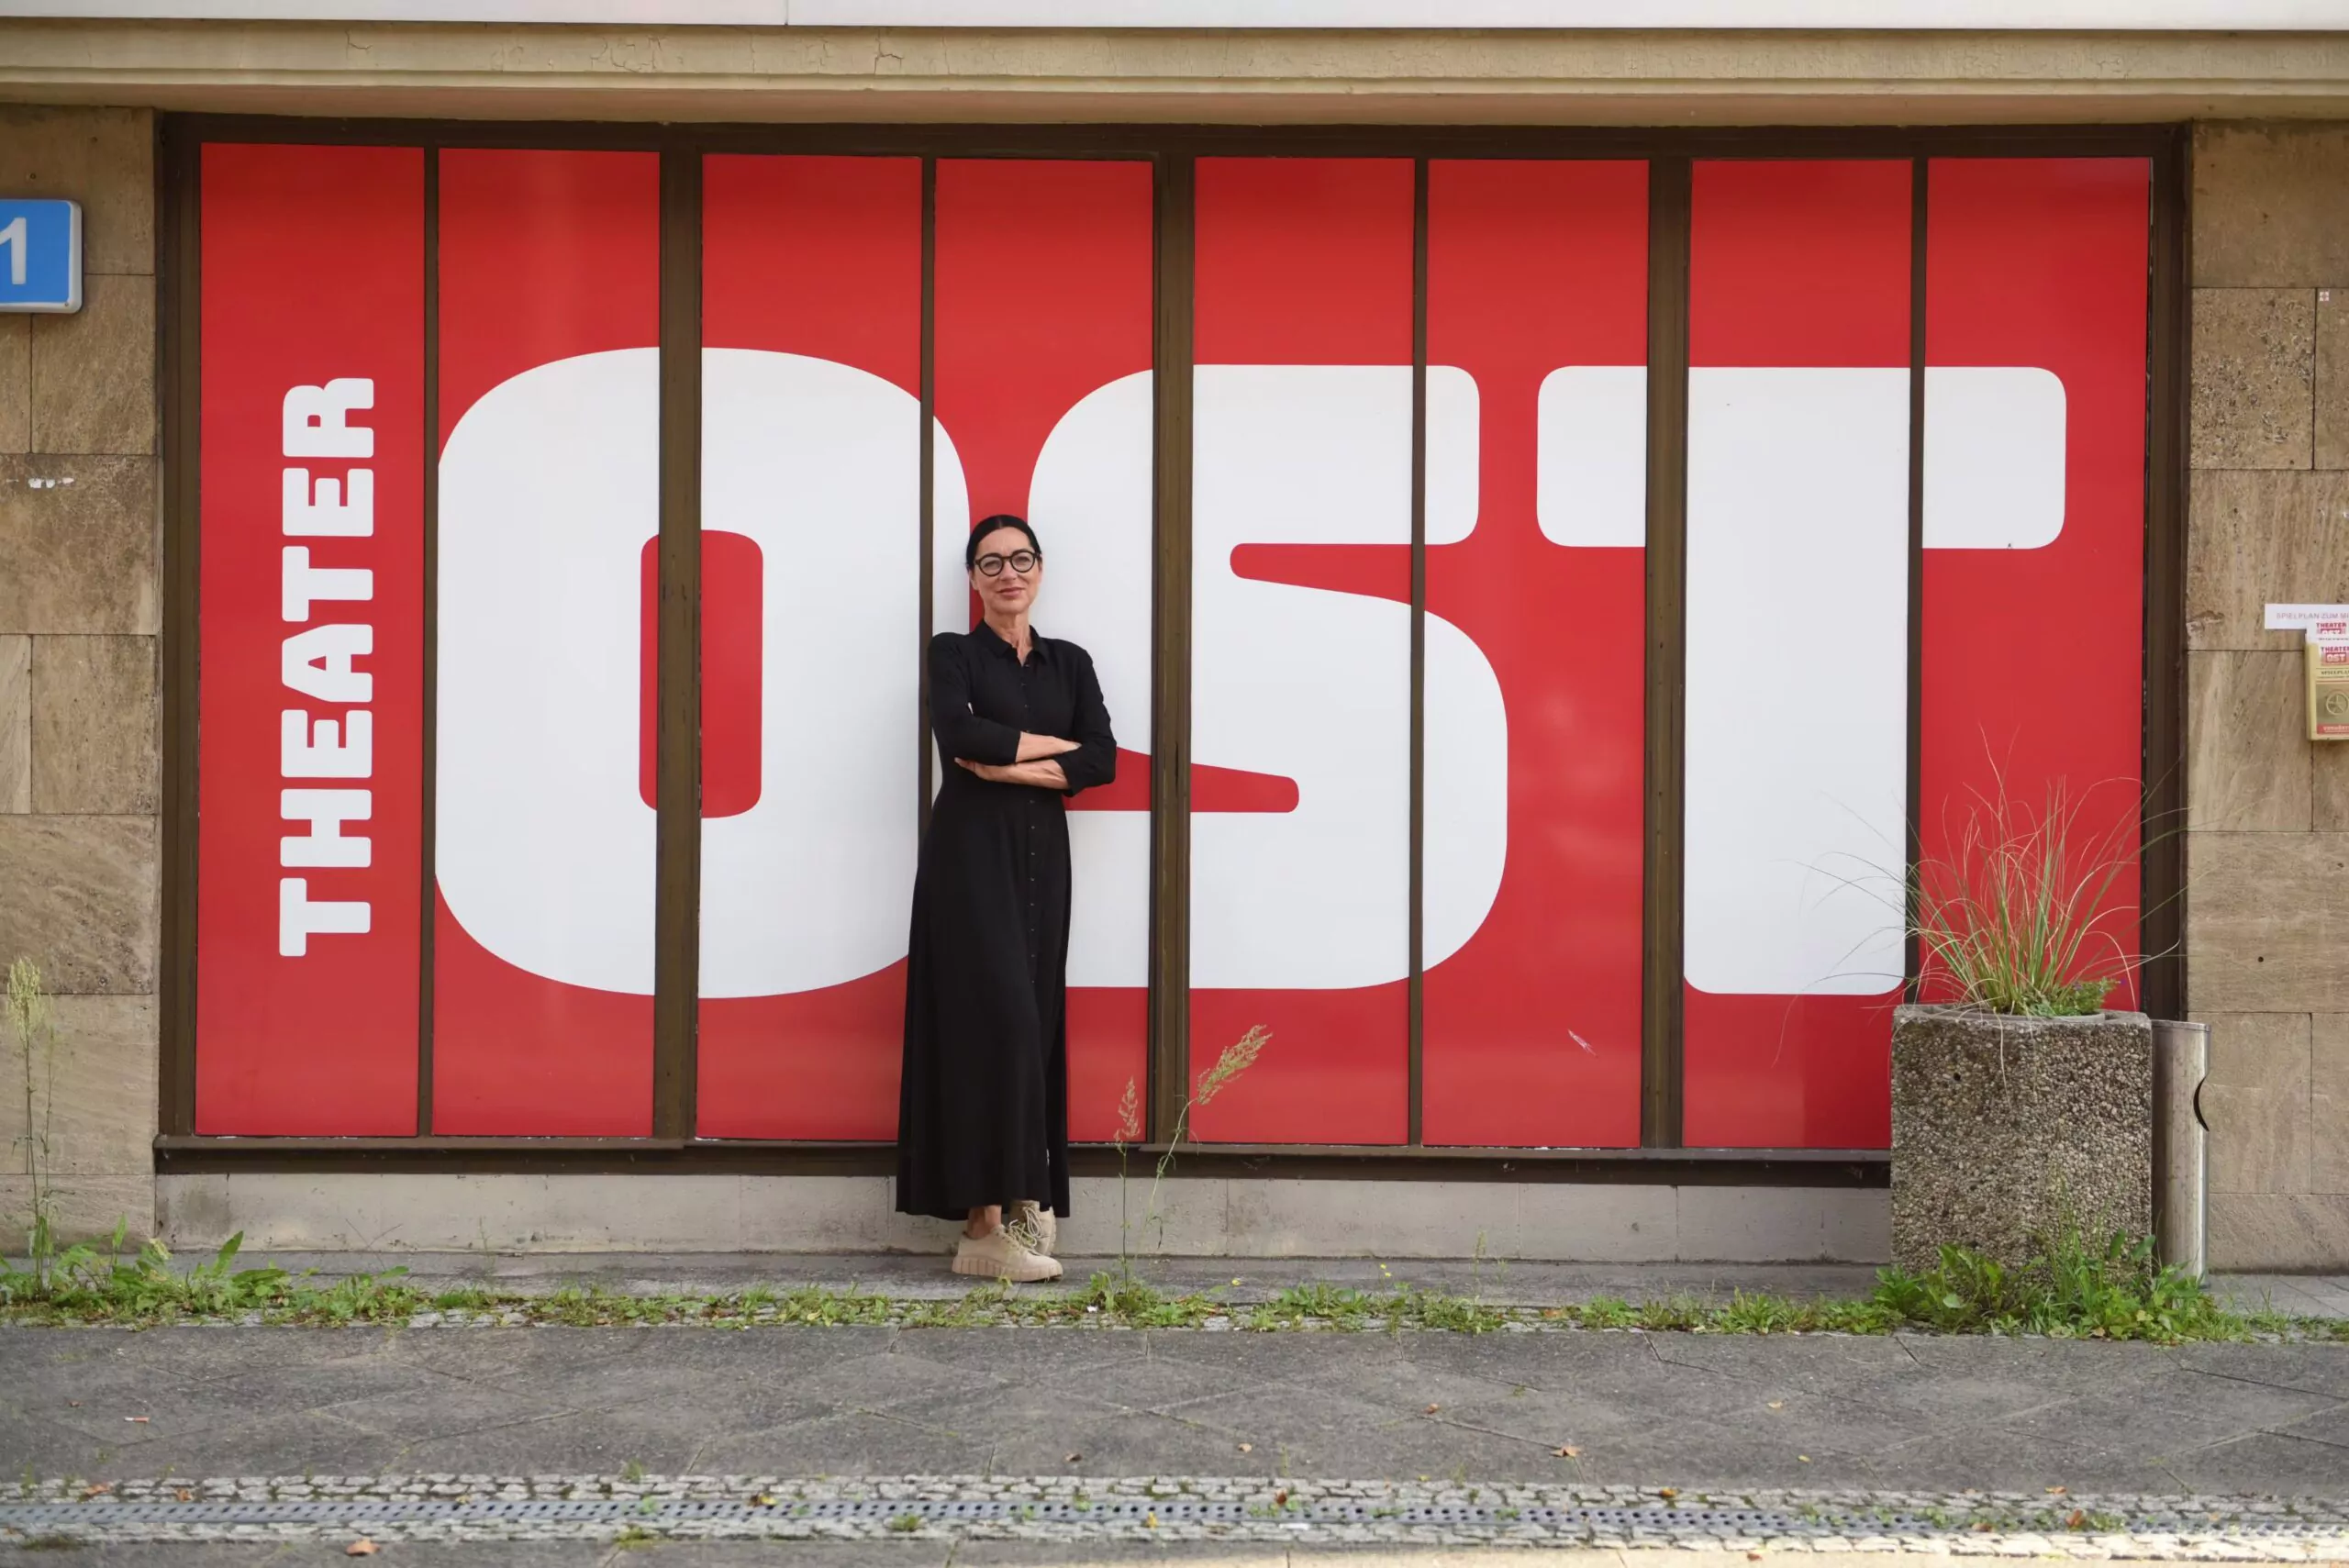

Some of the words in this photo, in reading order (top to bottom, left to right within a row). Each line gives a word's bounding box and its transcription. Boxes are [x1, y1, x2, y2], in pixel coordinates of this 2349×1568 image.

[279, 377, 375, 957] THEATER
[435, 347, 2066, 998] OST
[2276, 612, 2319, 620] SPIELPLAN
[2326, 653, 2345, 662] OST
